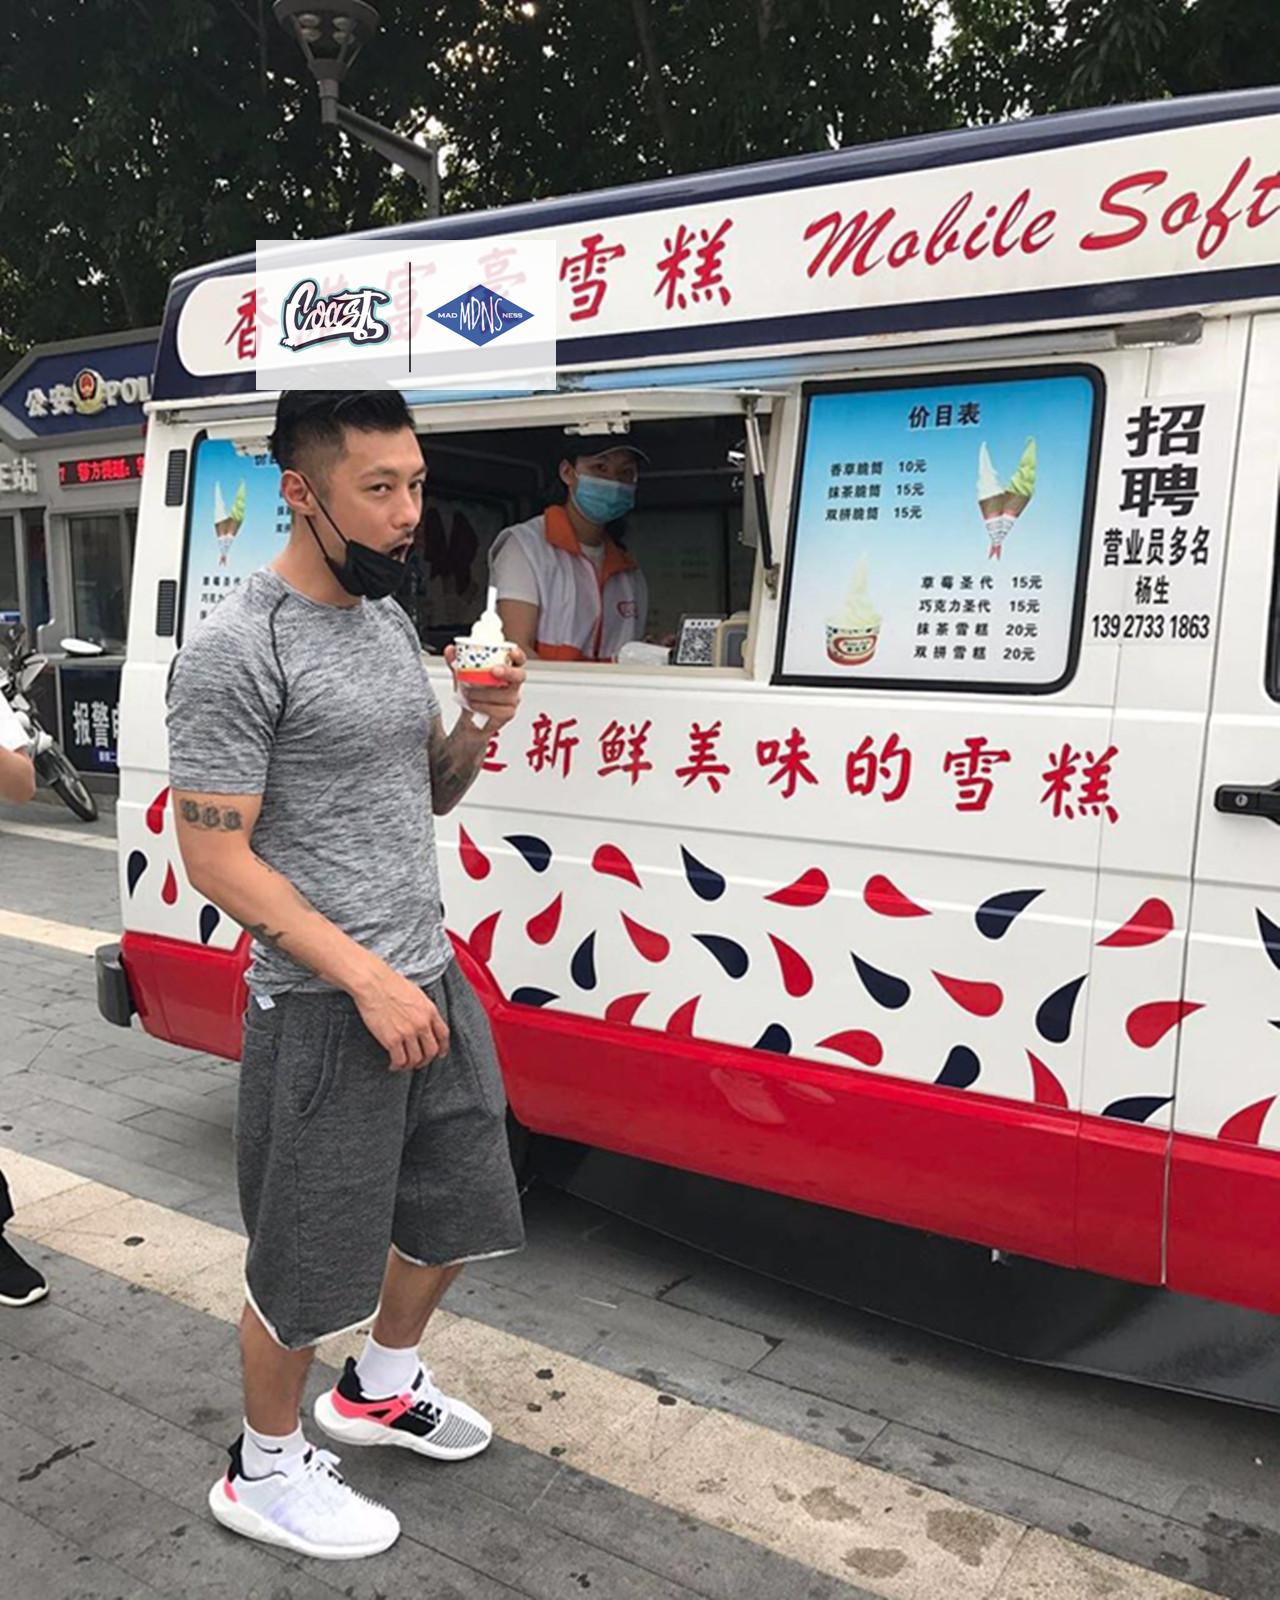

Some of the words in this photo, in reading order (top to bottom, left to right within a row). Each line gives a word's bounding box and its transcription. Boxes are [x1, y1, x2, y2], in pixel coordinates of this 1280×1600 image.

[803, 189, 1057, 278] Mobile
[1079, 157, 1280, 260] Soft
[908, 402, 981, 429] 价目表
[830, 460, 884, 477] 香草脆筒
[898, 458, 927, 474] 10元
[1119, 404, 1205, 518] 招聘
[828, 483, 881, 500] 抹茶脆筒
[896, 482, 925, 497] 15元
[893, 505, 923, 520] 15元
[1103, 525, 1210, 566] 营业员多名
[920, 575, 994, 590] 草莓圣代
[1012, 574, 1043, 590] 15元
[1135, 575, 1170, 604] 杨生
[918, 599, 992, 613] 巧克力圣代
[1009, 598, 1041, 613] 15元
[916, 621, 989, 637] 抹茶雪糕
[1005, 622, 1038, 638] 20元
[1093, 614, 1121, 638] 139
[1123, 614, 1165, 639] 2733
[1170, 614, 1210, 639] 1863
[913, 645, 987, 660] 双拼雪糕
[1003, 646, 1036, 662] 20元
